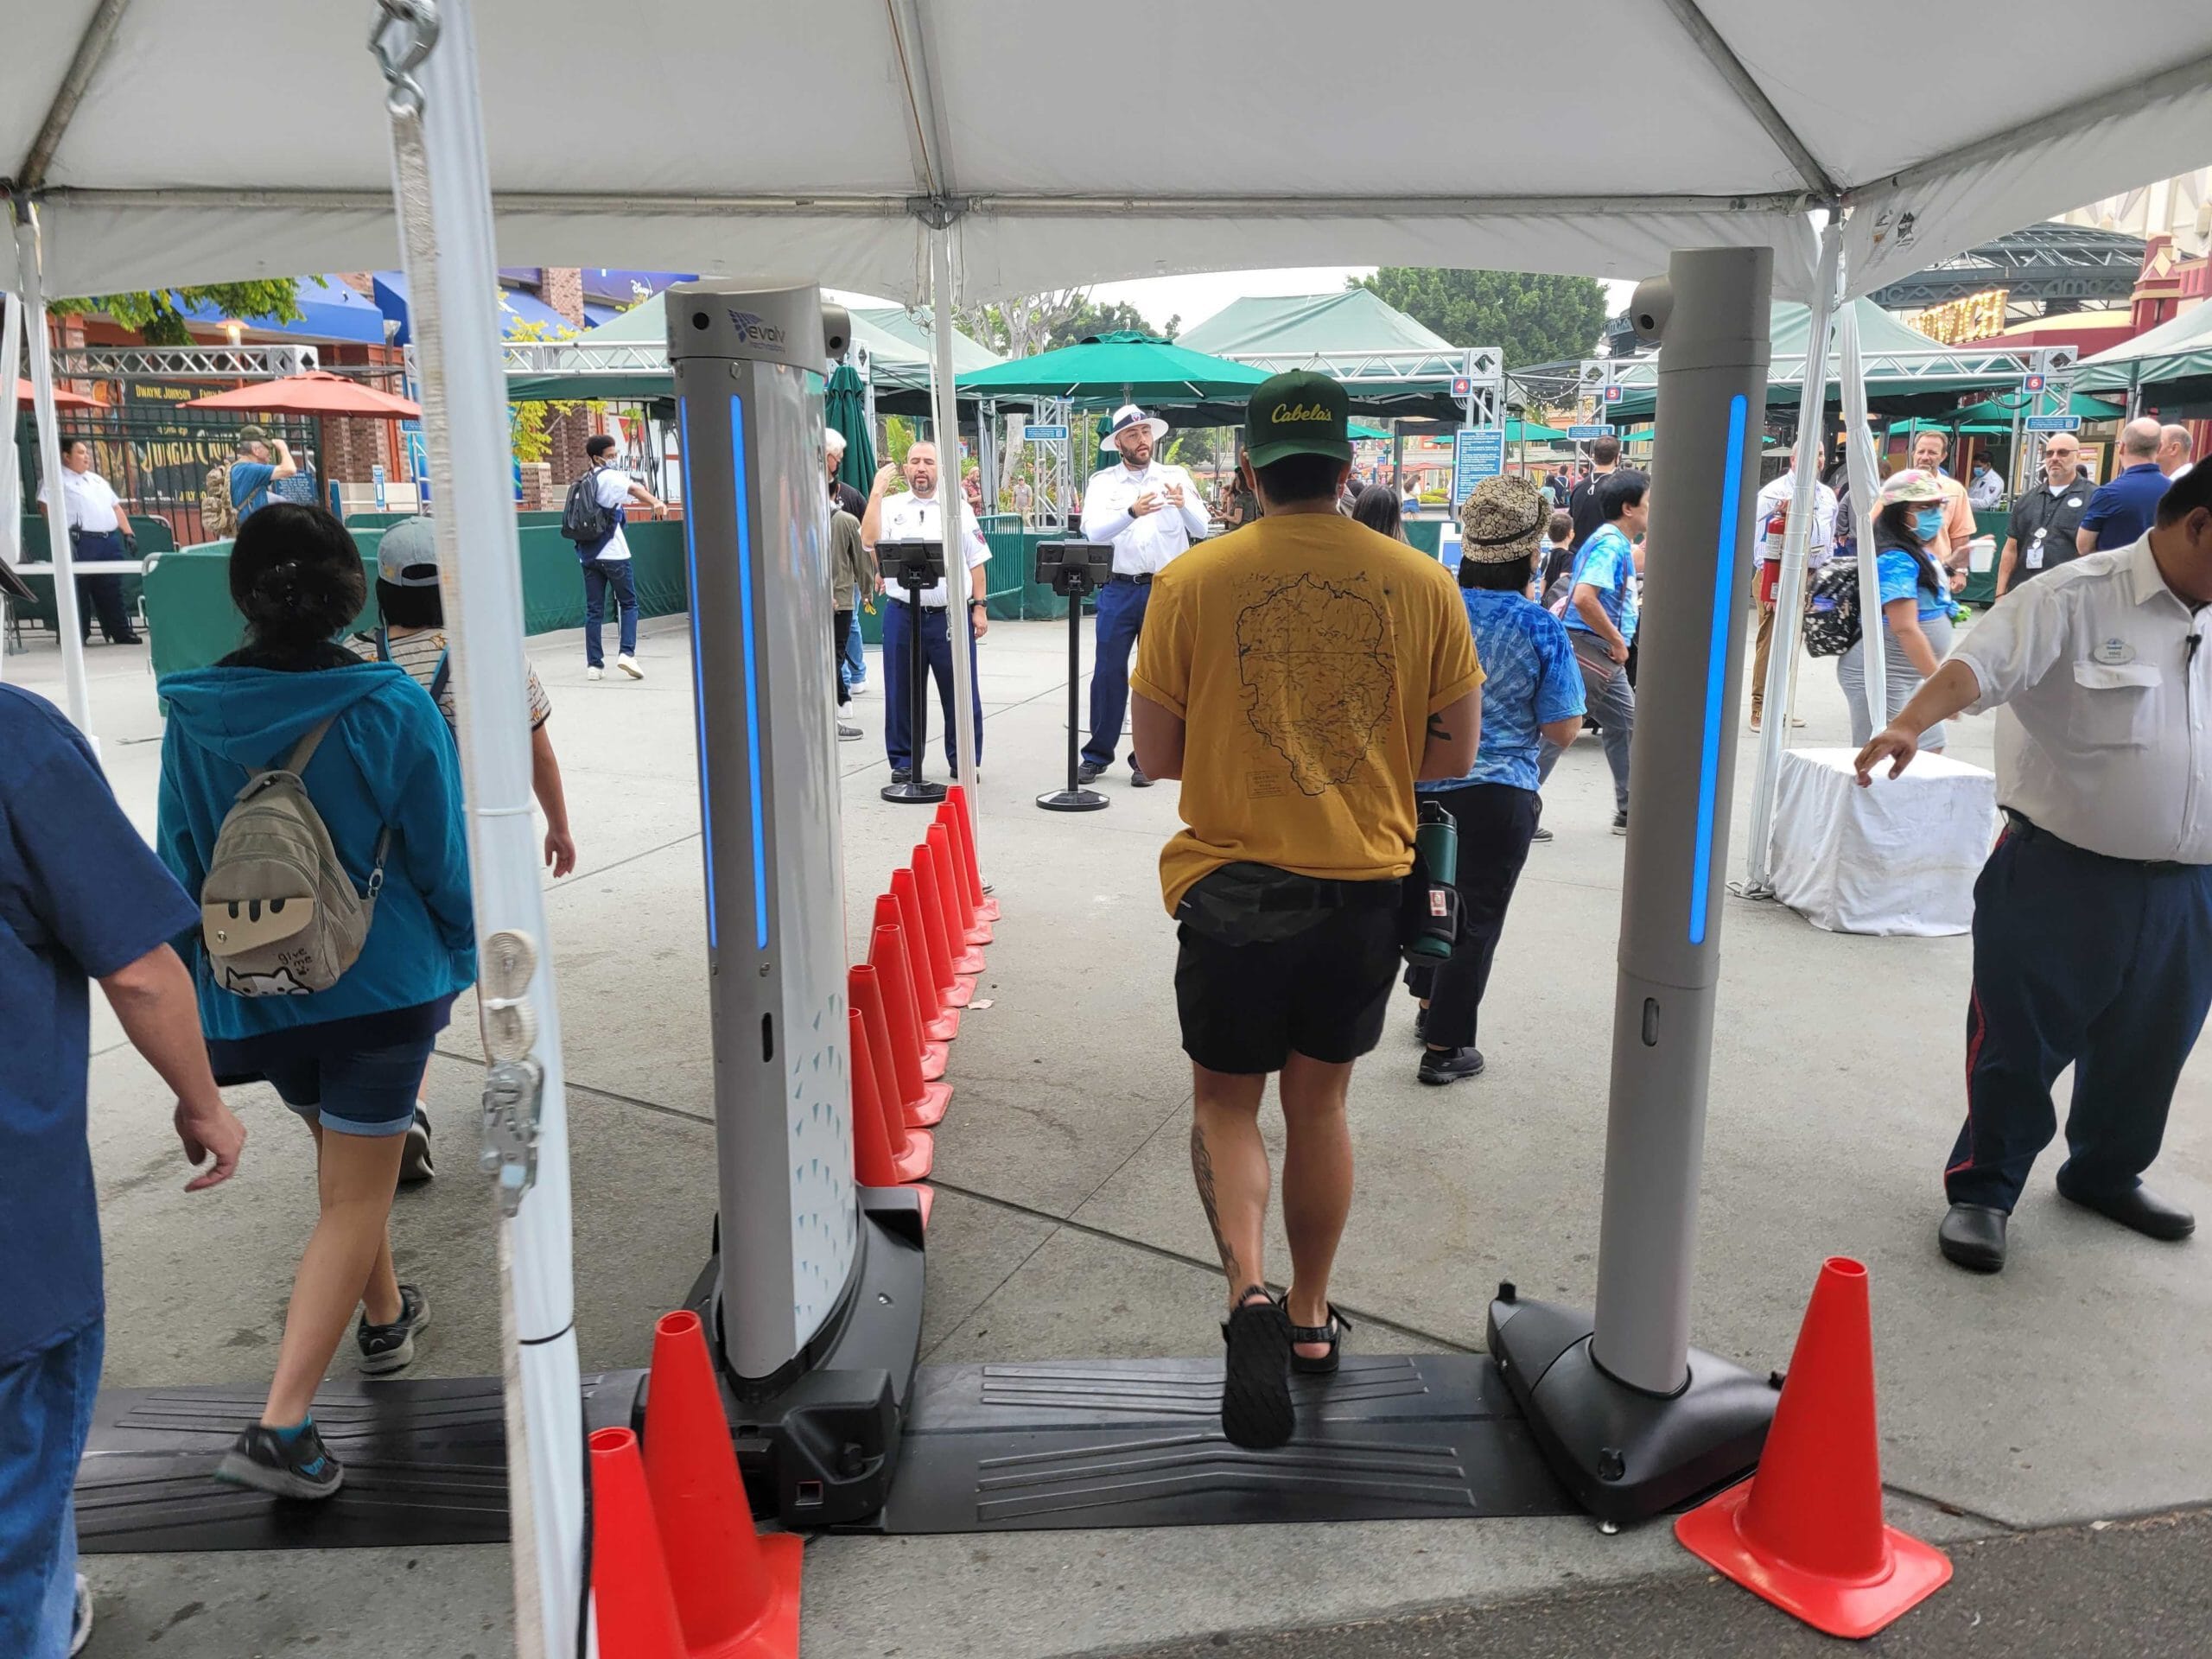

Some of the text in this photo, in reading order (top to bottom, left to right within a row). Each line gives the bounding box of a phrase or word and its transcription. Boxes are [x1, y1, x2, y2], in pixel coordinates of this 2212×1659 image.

[748, 325, 785, 343] evolv
[2031, 378, 2039, 387] 6
[136, 385, 162, 398] DWAYNE
[163, 386, 191, 400] JOHNSON
[1610, 388, 1617, 397] 5
[1271, 403, 1332, 423] Cabela's
[278, 948, 308, 965] give
[294, 956, 313, 966] me
